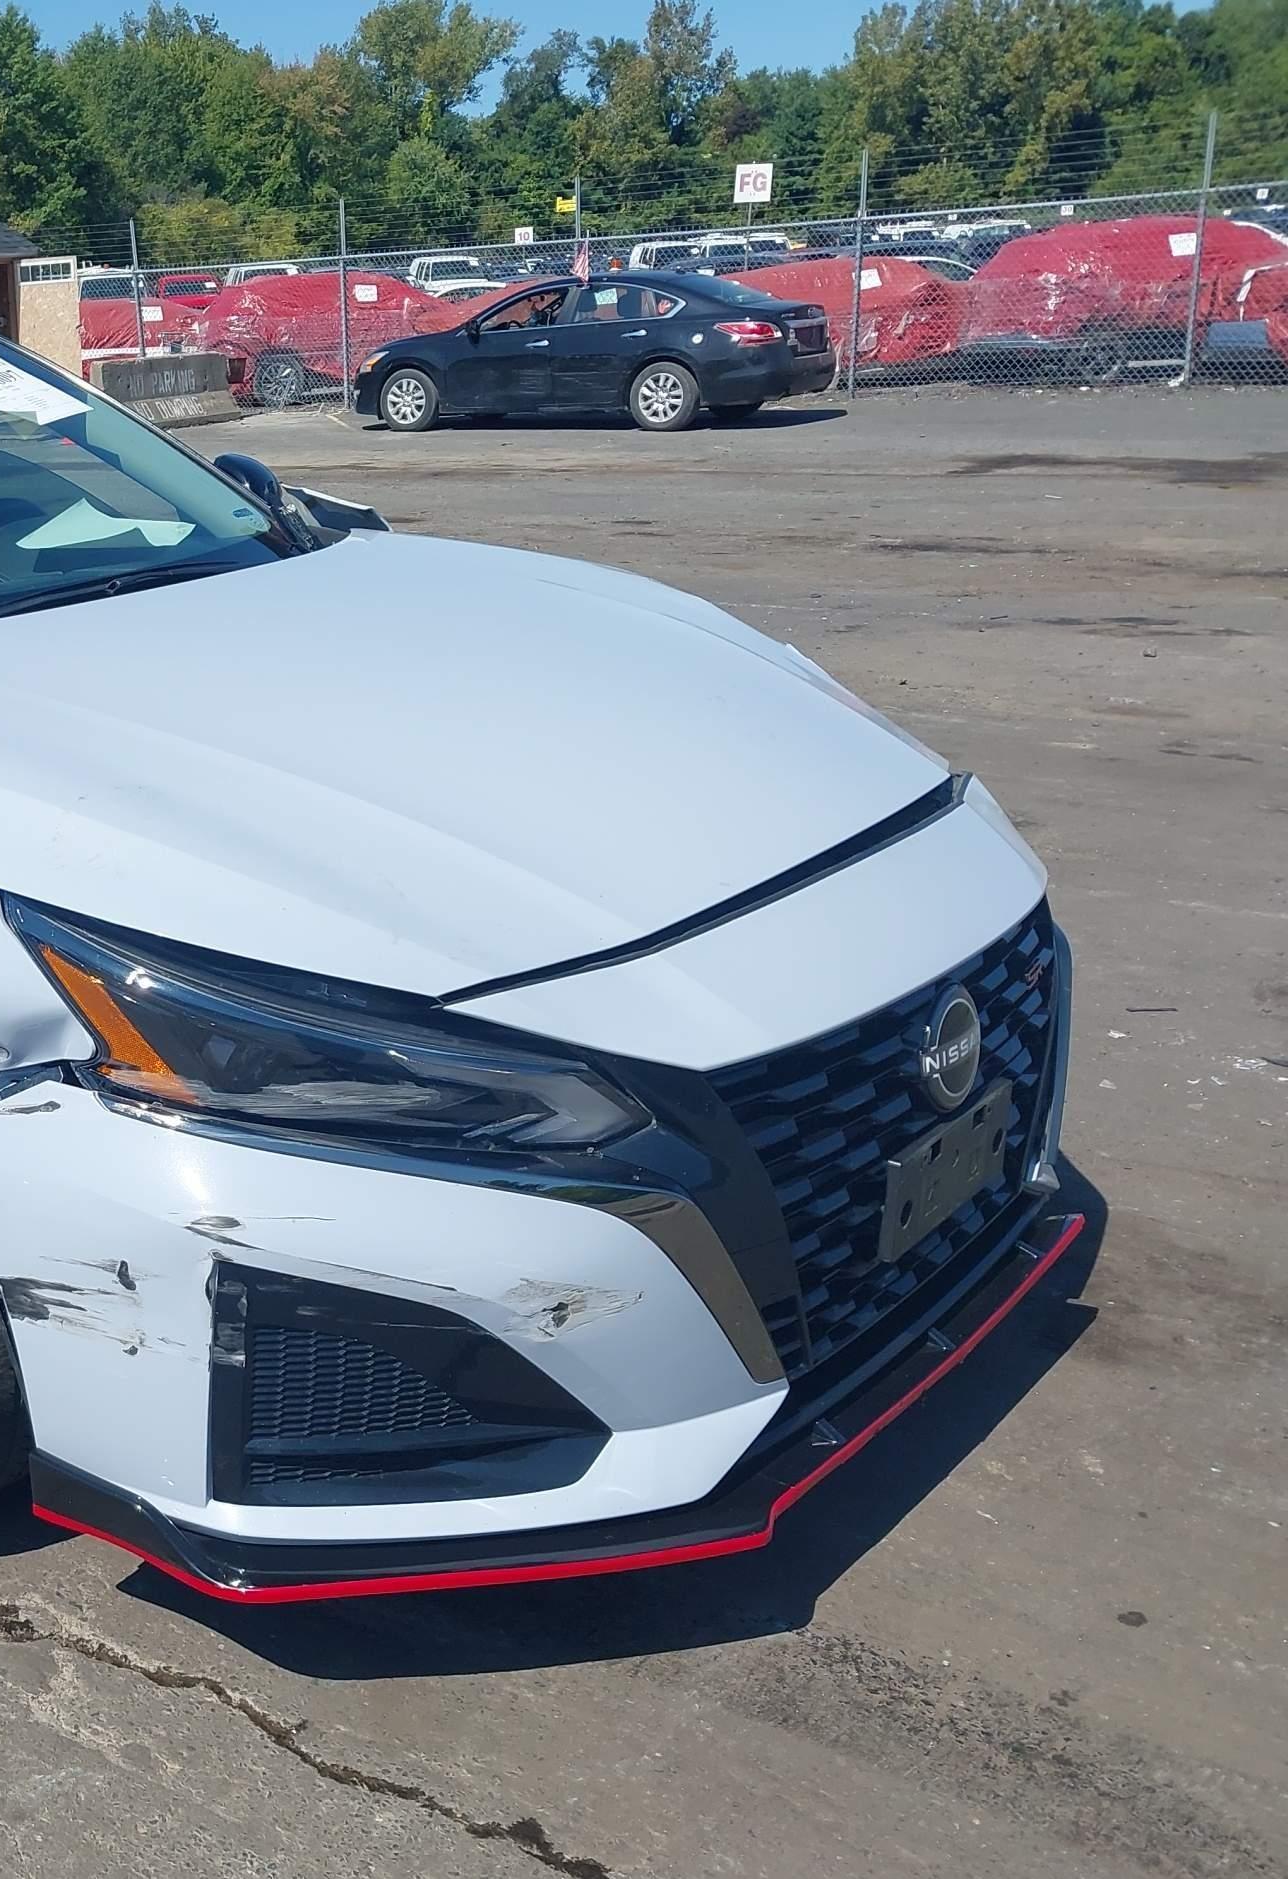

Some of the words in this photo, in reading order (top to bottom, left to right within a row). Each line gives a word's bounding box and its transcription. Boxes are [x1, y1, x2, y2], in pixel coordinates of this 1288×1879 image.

[739, 172, 767, 192] FG
[518, 231, 530, 241] 10
[152, 369, 195, 395] PARKING
[923, 1033, 978, 1074] NISSA
